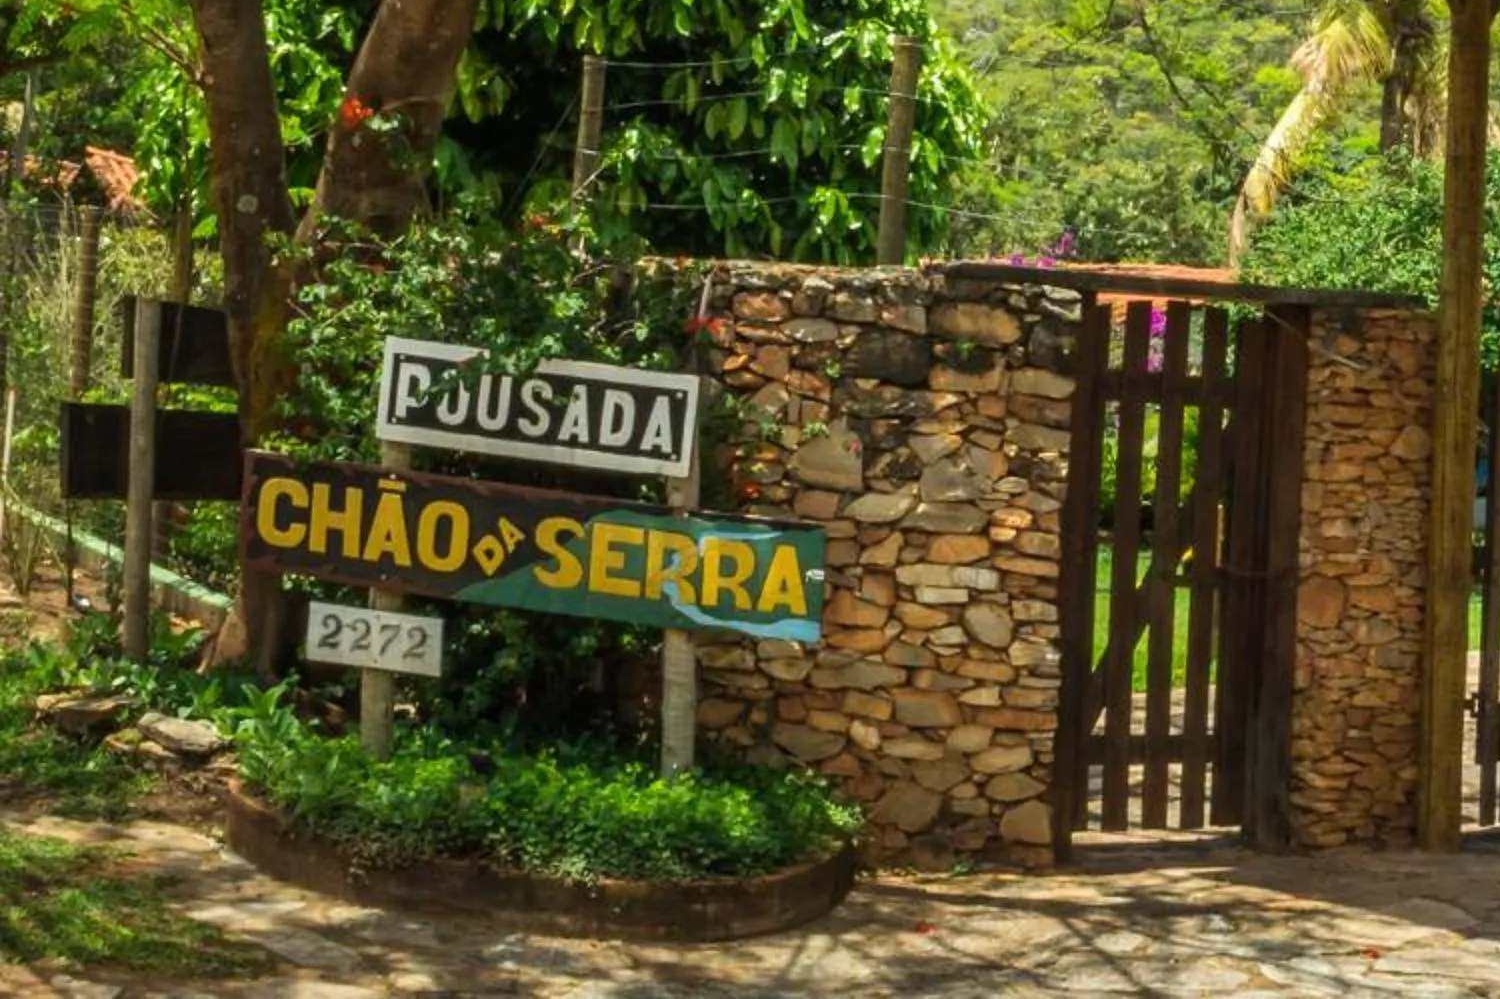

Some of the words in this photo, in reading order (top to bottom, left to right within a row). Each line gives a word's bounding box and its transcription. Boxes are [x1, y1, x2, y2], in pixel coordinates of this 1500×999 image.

[257, 477, 469, 572] CHÃO
[473, 517, 525, 576] DA
[533, 517, 807, 615] SERRA
[317, 613, 429, 660] 2272
